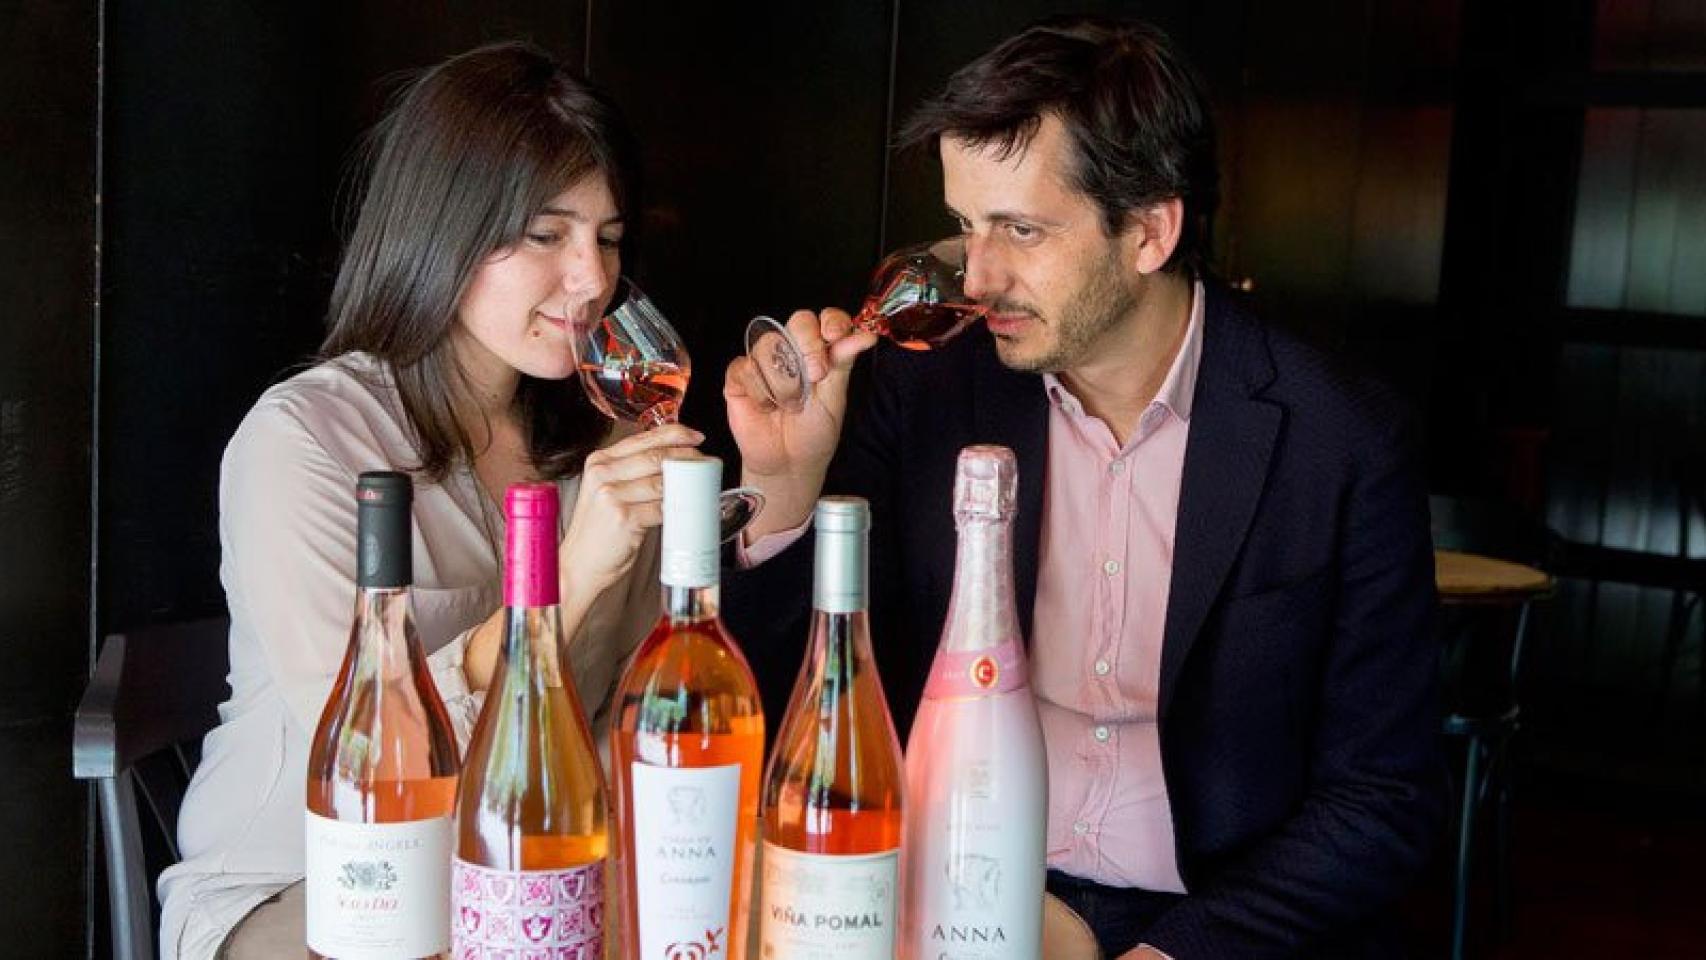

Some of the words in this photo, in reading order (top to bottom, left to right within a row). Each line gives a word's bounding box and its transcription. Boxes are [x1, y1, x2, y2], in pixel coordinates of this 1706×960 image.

[657, 846, 716, 859] ANNA
[771, 904, 808, 927] VIÑA
[814, 912, 883, 931] POMAL
[931, 923, 1006, 941] ANNA
